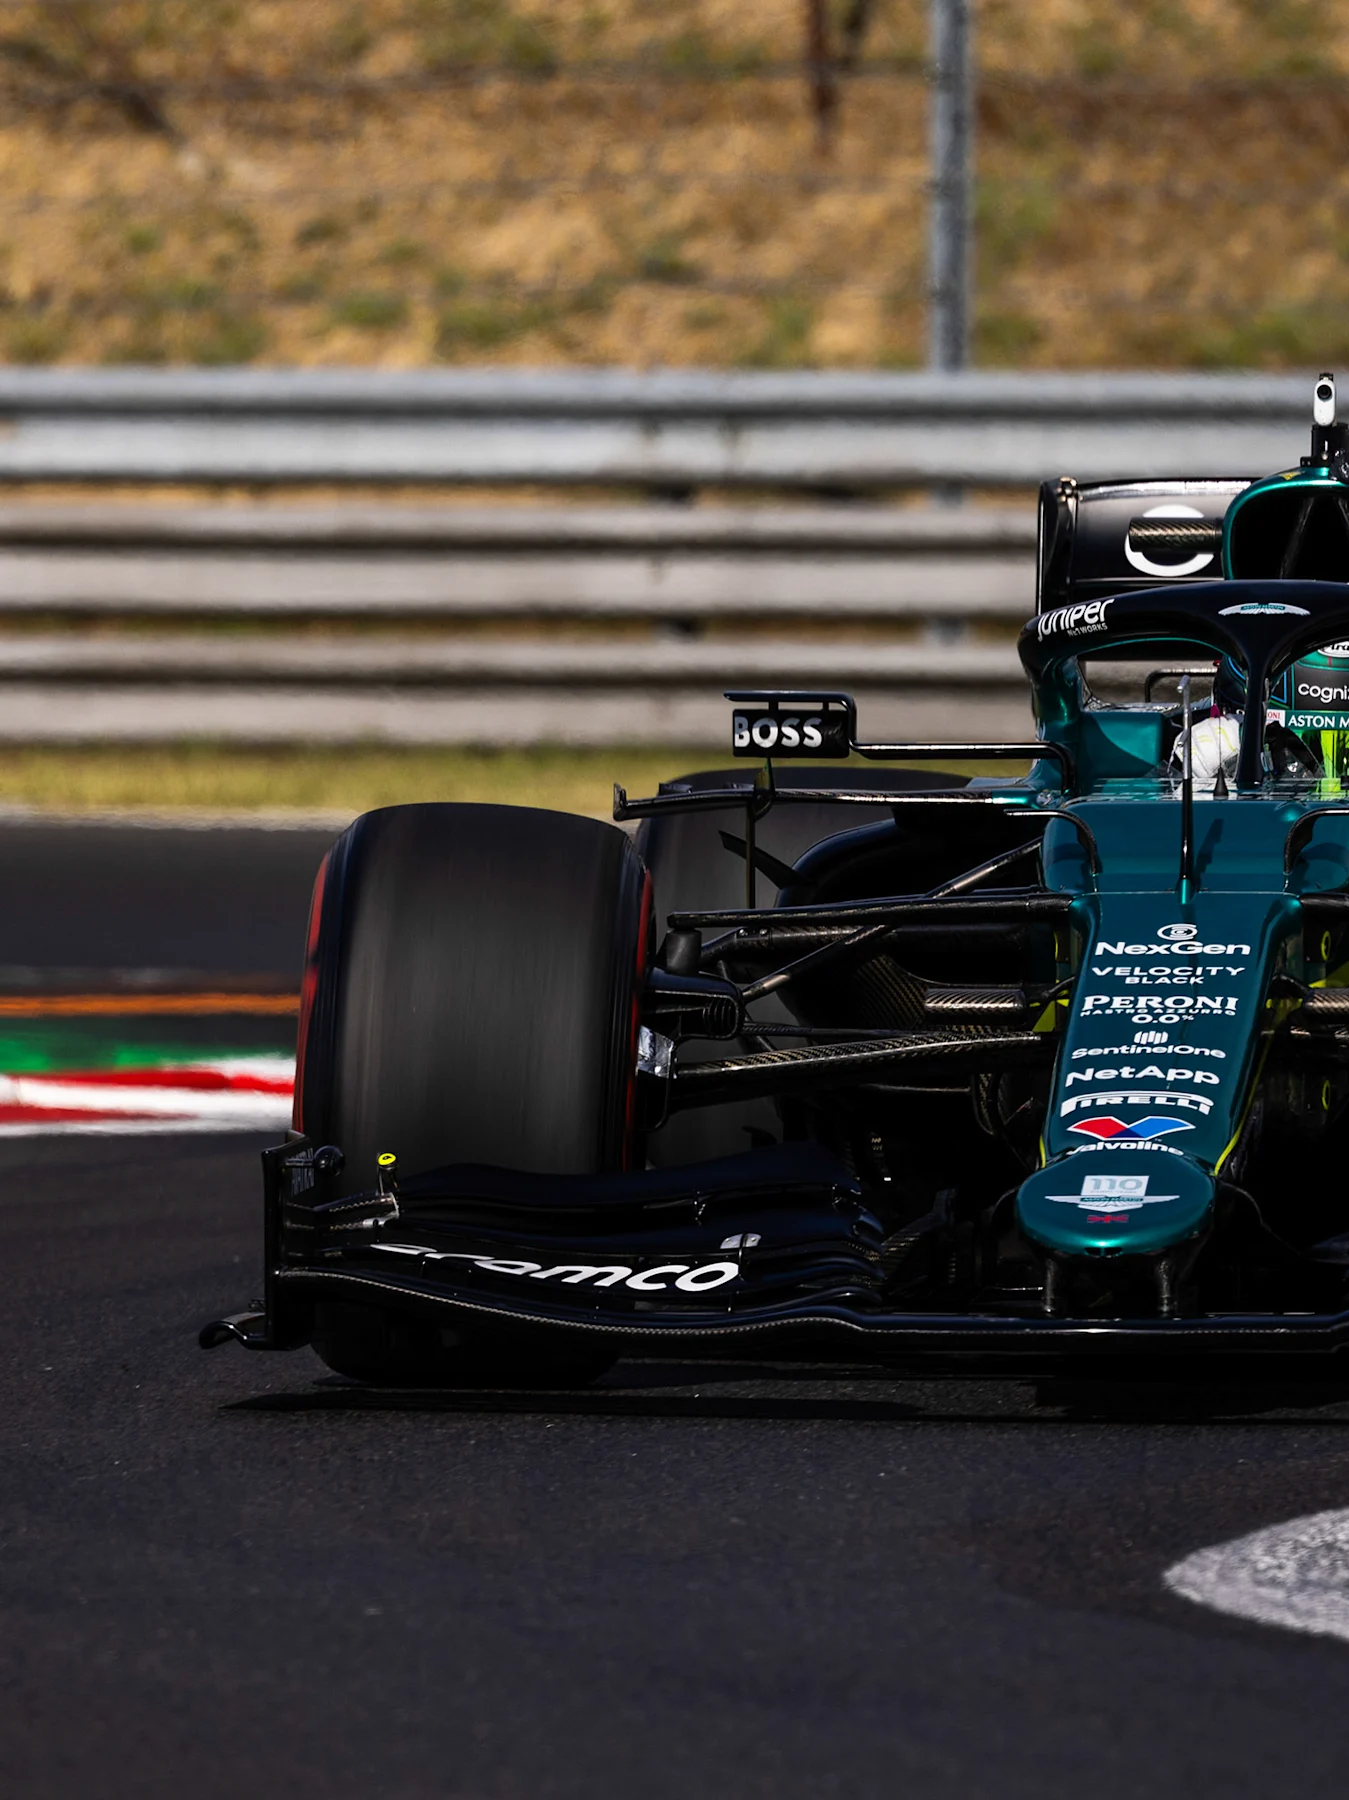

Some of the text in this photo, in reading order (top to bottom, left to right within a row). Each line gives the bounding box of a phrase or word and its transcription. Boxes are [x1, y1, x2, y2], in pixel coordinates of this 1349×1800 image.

[1288, 714, 1336, 729] ASTON
[734, 716, 823, 748] BOSS
[1095, 941, 1251, 956] NexGen
[1092, 966, 1246, 976] VELOCITY
[1125, 977, 1205, 985] BLACK
[1082, 995, 1239, 1011] PERONI
[1080, 1009, 1149, 1017] NASTRO
[1131, 1014, 1195, 1024] 0.0%
[1071, 1045, 1227, 1060] SentinelOne
[1065, 1065, 1220, 1087] NetApp
[1060, 1091, 1214, 1117] PIRELLI
[1089, 1178, 1143, 1191] 110
[369, 1243, 740, 1292] aramco
